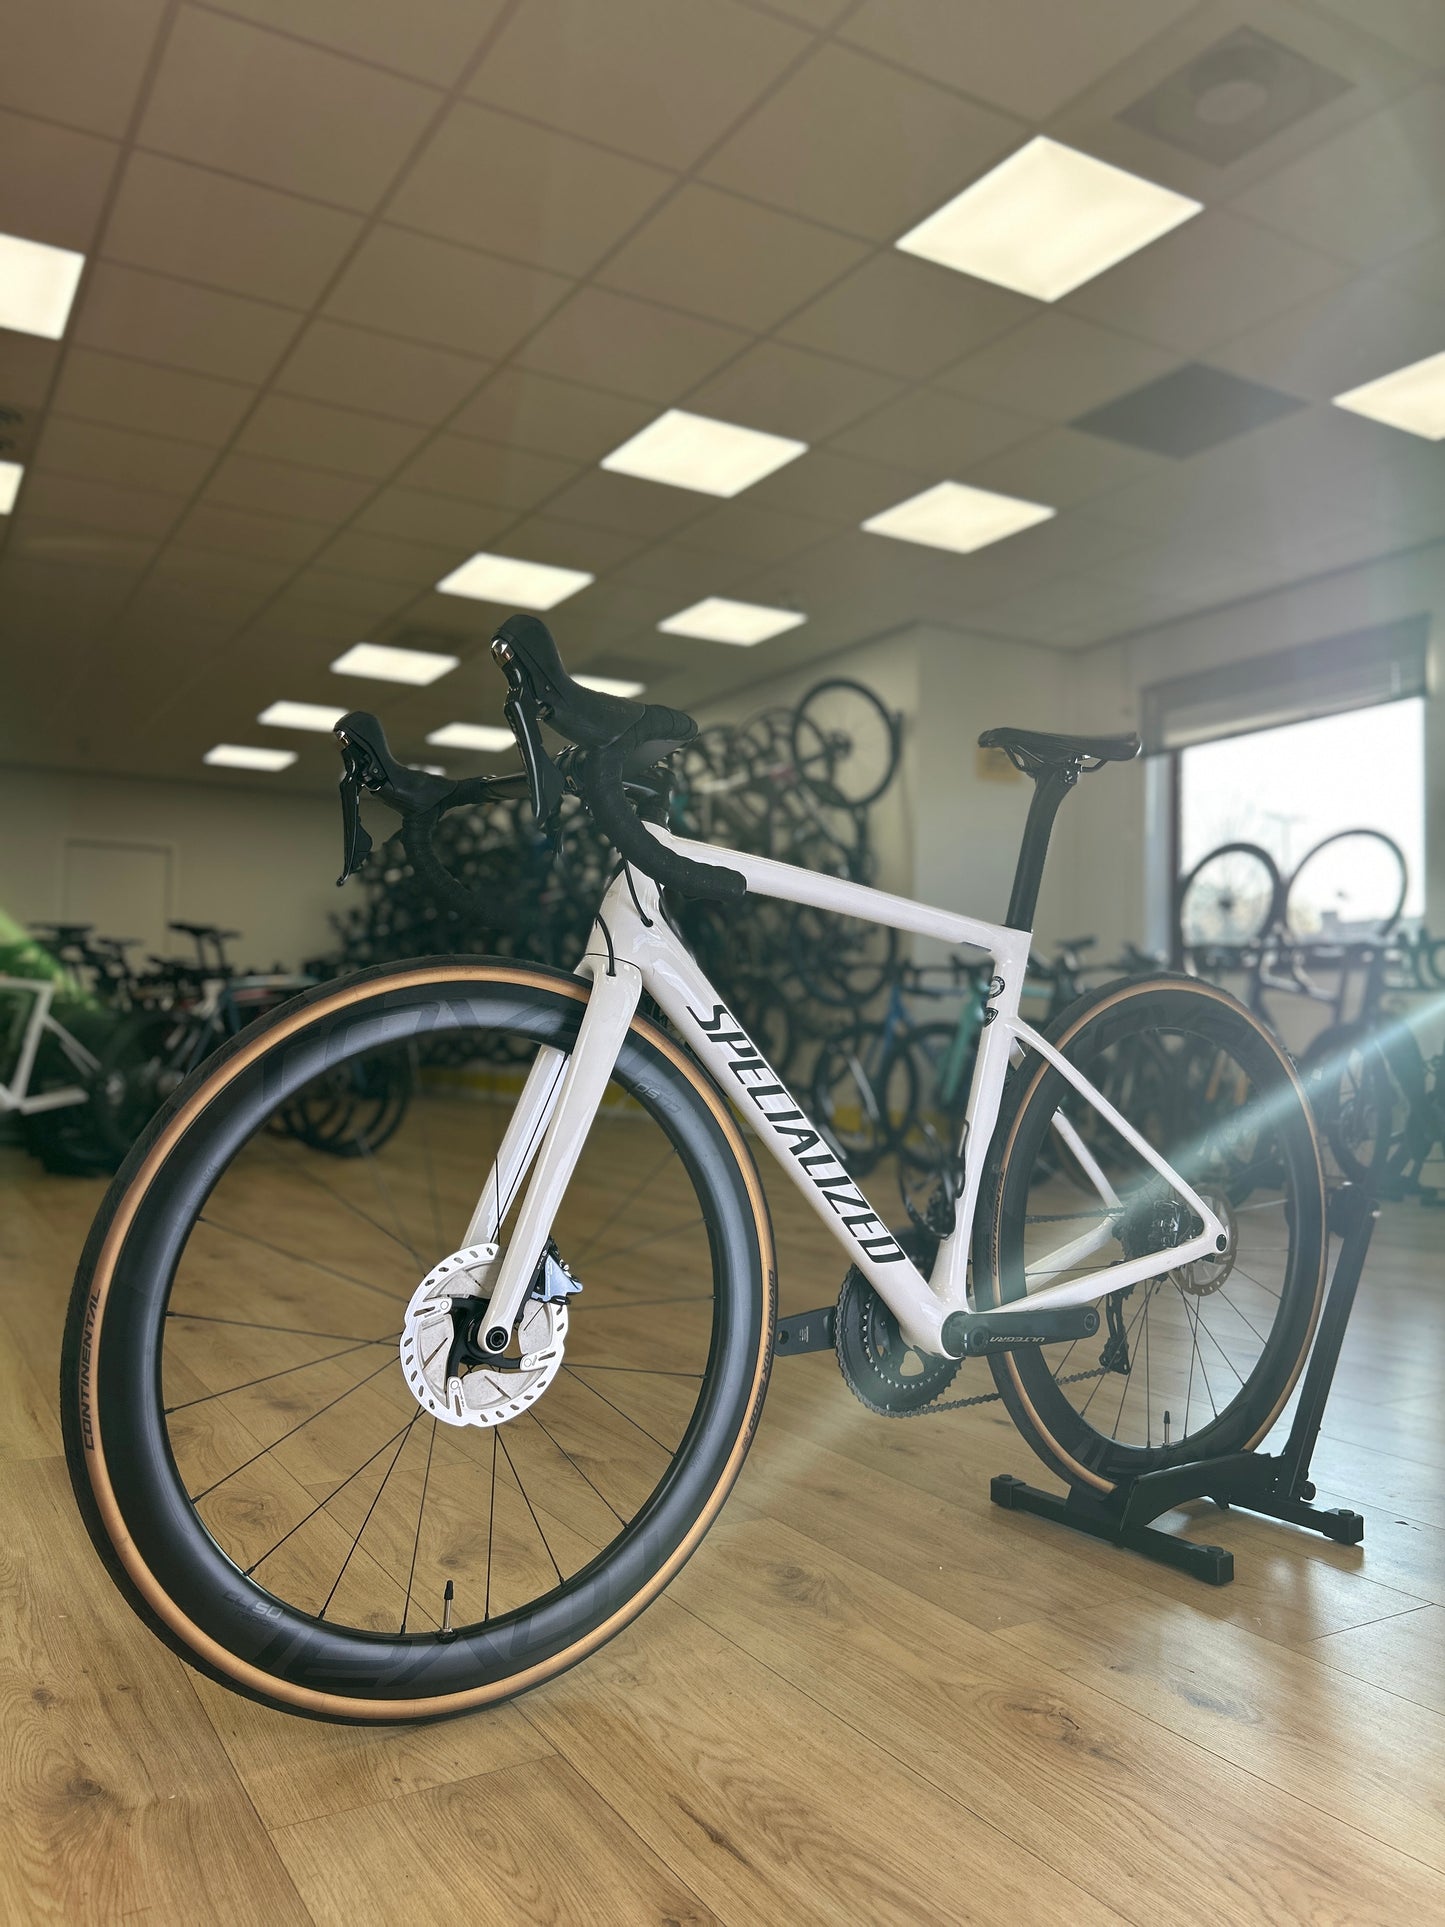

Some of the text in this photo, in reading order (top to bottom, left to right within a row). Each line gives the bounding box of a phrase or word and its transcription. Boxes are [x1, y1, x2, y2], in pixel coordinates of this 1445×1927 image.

[686, 1004, 906, 1264] SPECIALIZED
[991, 1167, 1006, 1277] CONTINENTAL
[80, 1288, 102, 1452] CONTINENTAL
[748, 1270, 775, 1432] GRAND PRIX 5000
[989, 1336, 1046, 1344] ULTEGRA
[252, 1601, 284, 1620] 50
